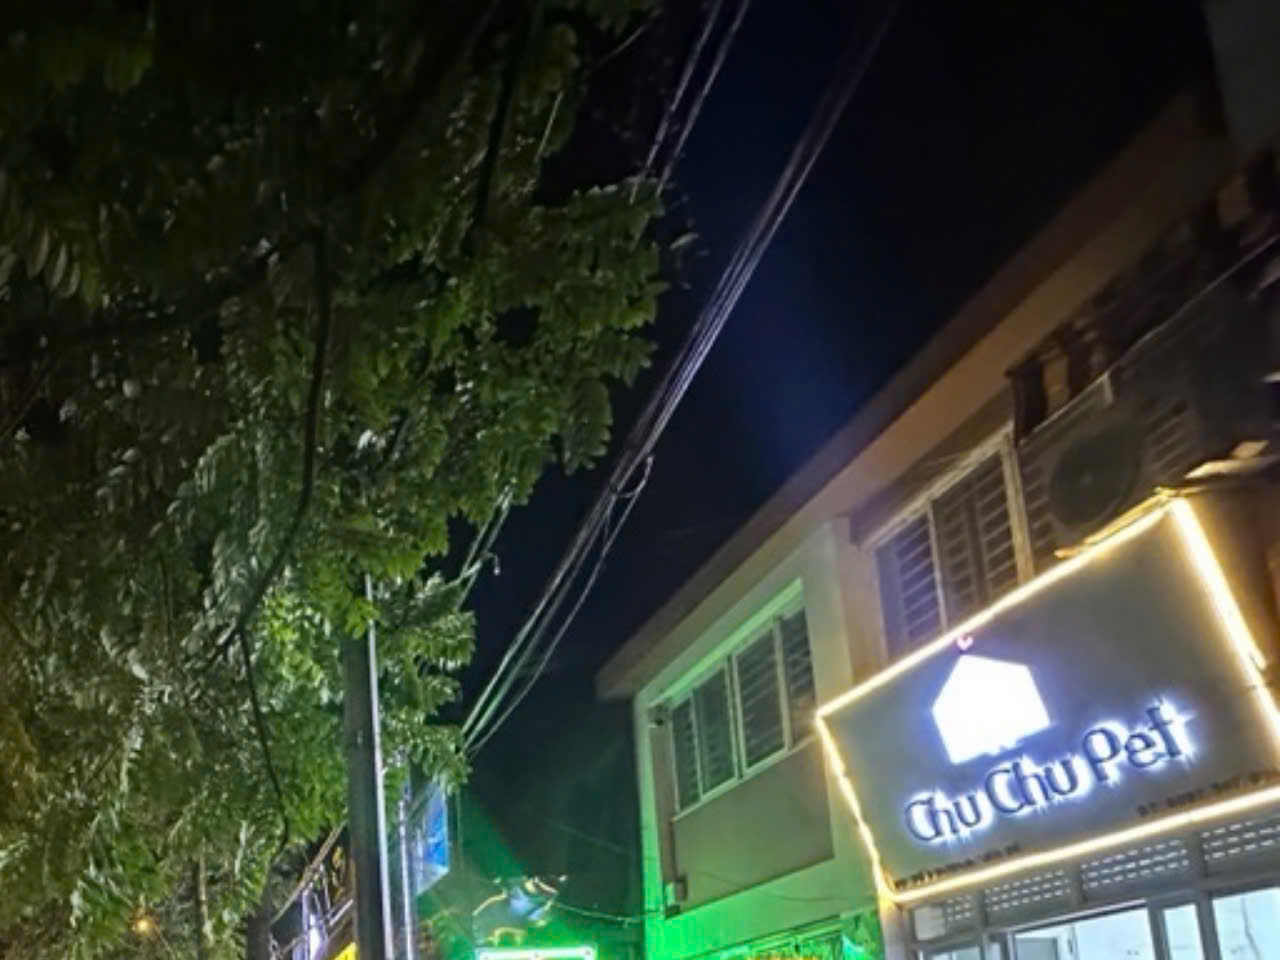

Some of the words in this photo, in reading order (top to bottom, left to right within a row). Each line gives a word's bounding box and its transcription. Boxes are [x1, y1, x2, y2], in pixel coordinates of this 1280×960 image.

[905, 794, 982, 842] Chu
[985, 759, 1079, 814] Chu
[1082, 704, 1184, 782] Pet
